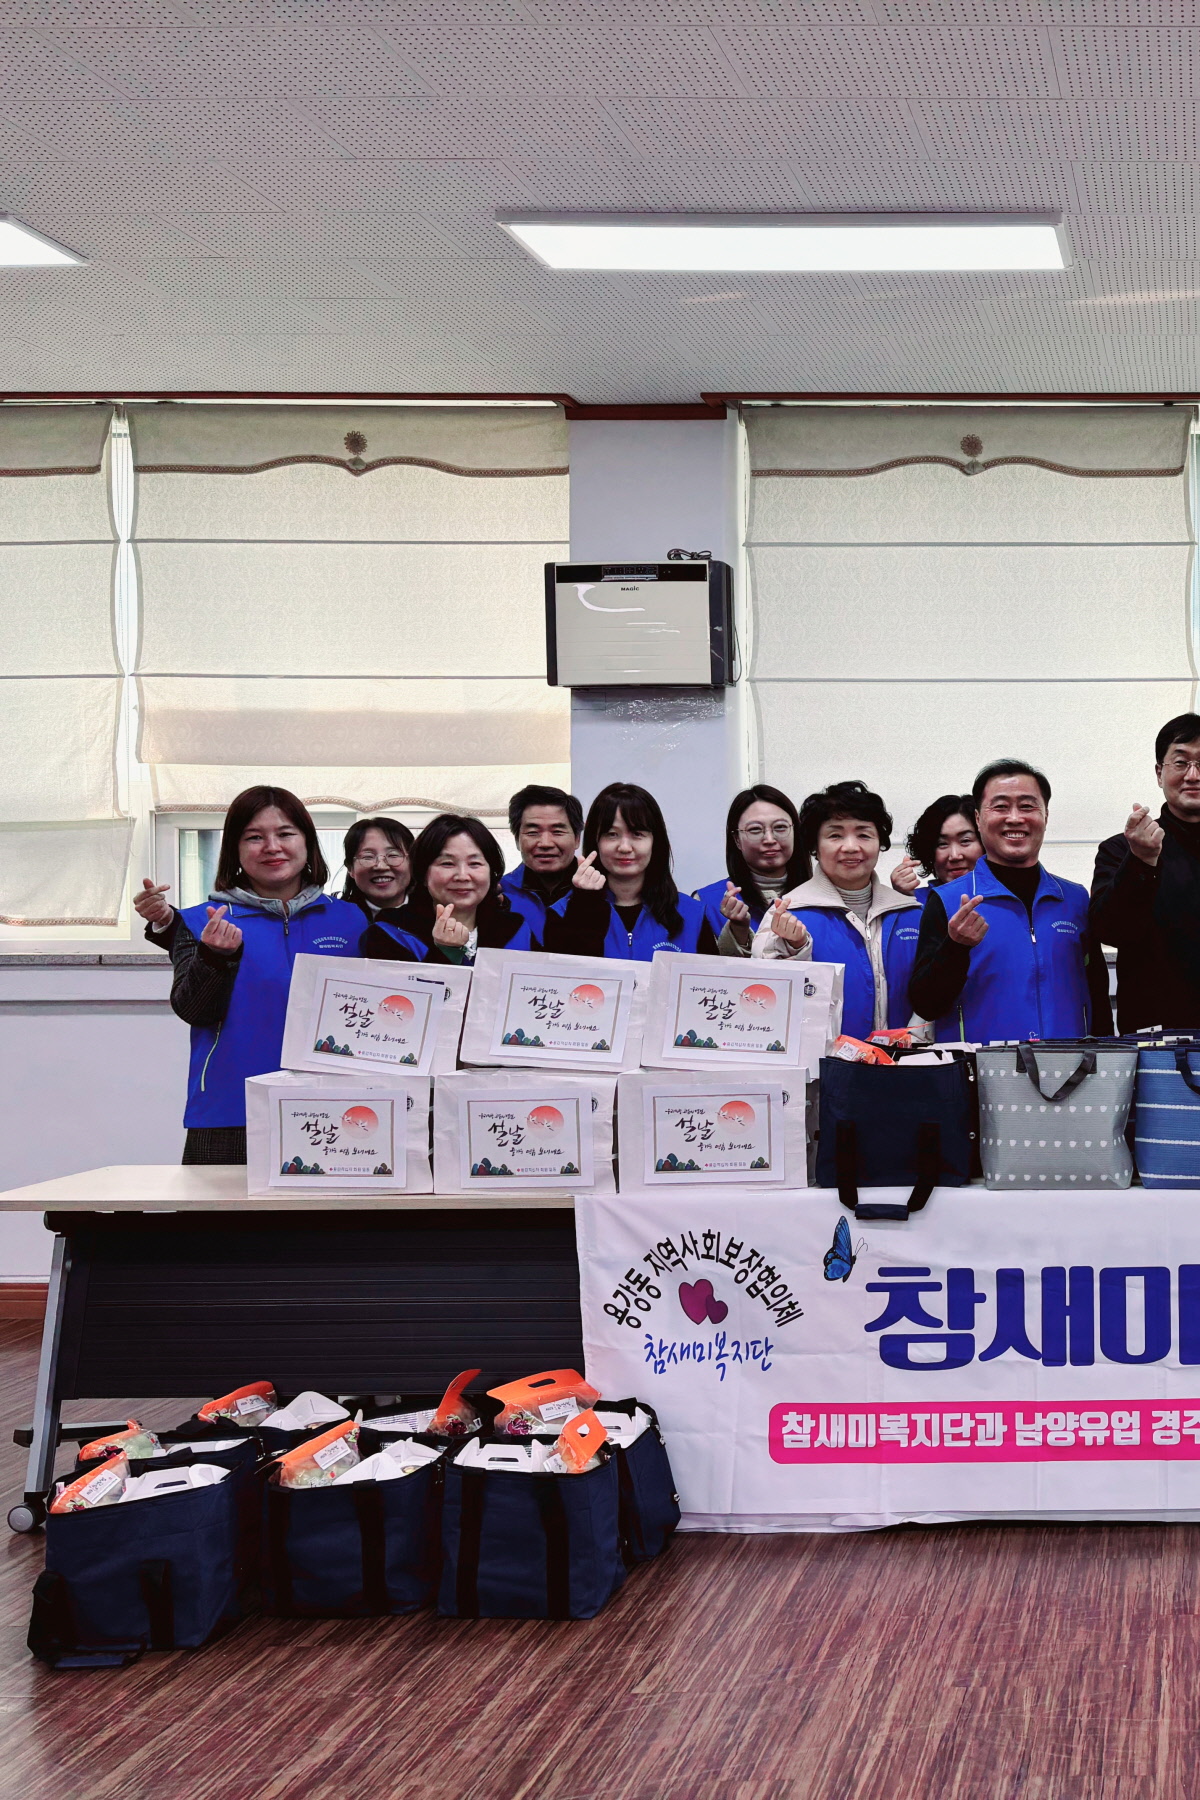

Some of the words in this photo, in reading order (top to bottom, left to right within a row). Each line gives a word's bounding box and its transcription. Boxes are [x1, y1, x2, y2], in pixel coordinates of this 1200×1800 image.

[339, 1002, 375, 1029] 설날
[527, 994, 566, 1020] 설날
[698, 994, 737, 1021] 설날
[300, 1119, 340, 1146] 설날
[487, 1120, 526, 1147] 설날
[675, 1115, 715, 1143] 설날
[644, 1331, 774, 1381] 참새미복지단
[781, 1411, 1007, 1449] 참새미복지단과
[1015, 1409, 1140, 1447] 남양유업
